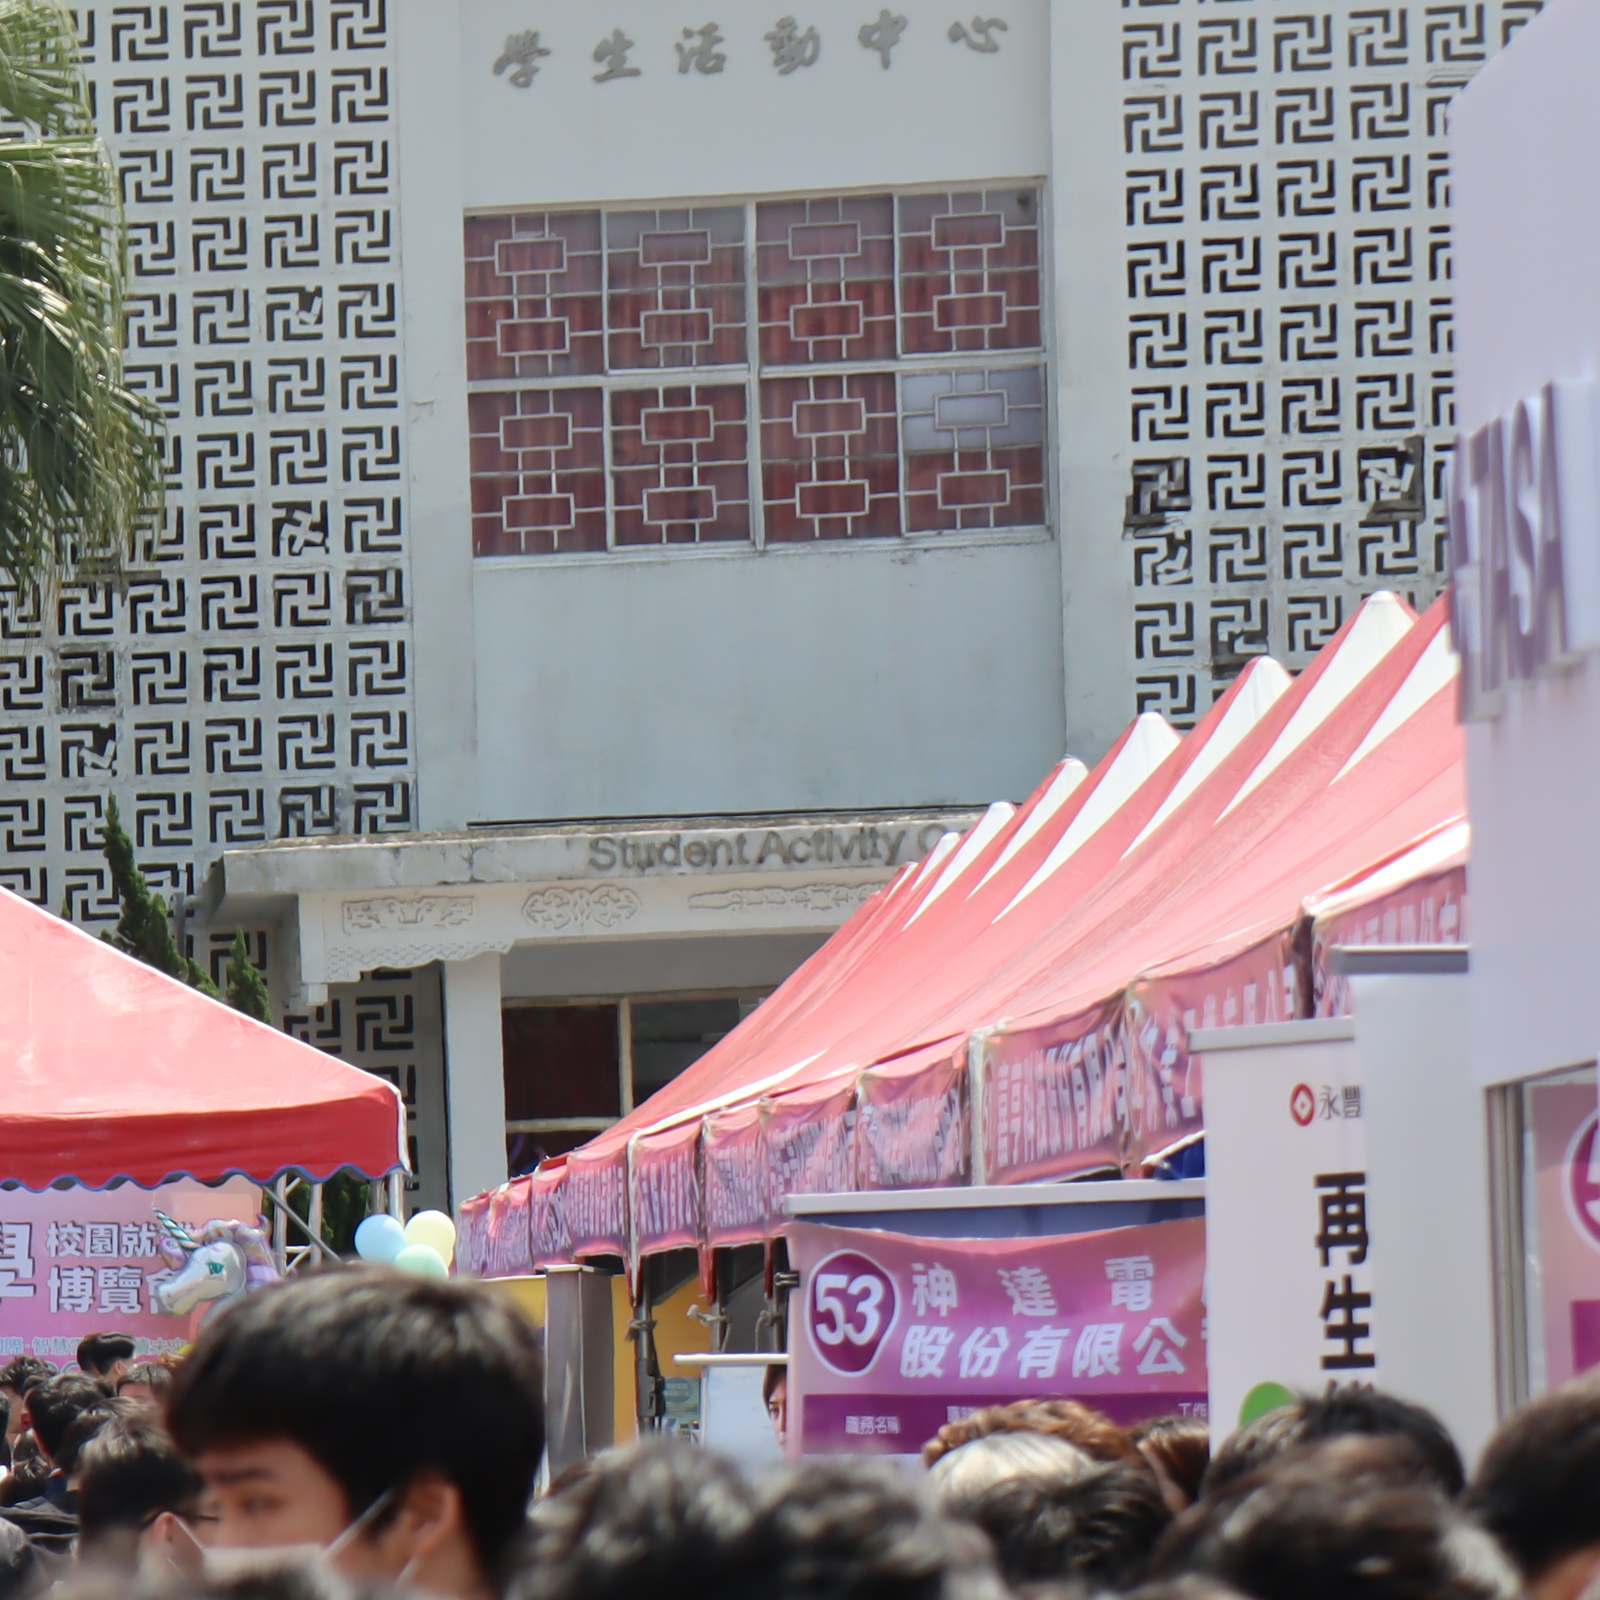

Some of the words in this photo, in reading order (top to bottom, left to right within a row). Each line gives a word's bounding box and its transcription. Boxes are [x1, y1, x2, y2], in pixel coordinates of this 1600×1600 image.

[493, 8, 1008, 88] 學生活動中心
[588, 833, 750, 870] Student
[755, 825, 907, 867] Activity
[814, 1273, 885, 1346] 53
[1313, 1171, 1375, 1400] 再生
[899, 1316, 1206, 1380] 股份有限公
